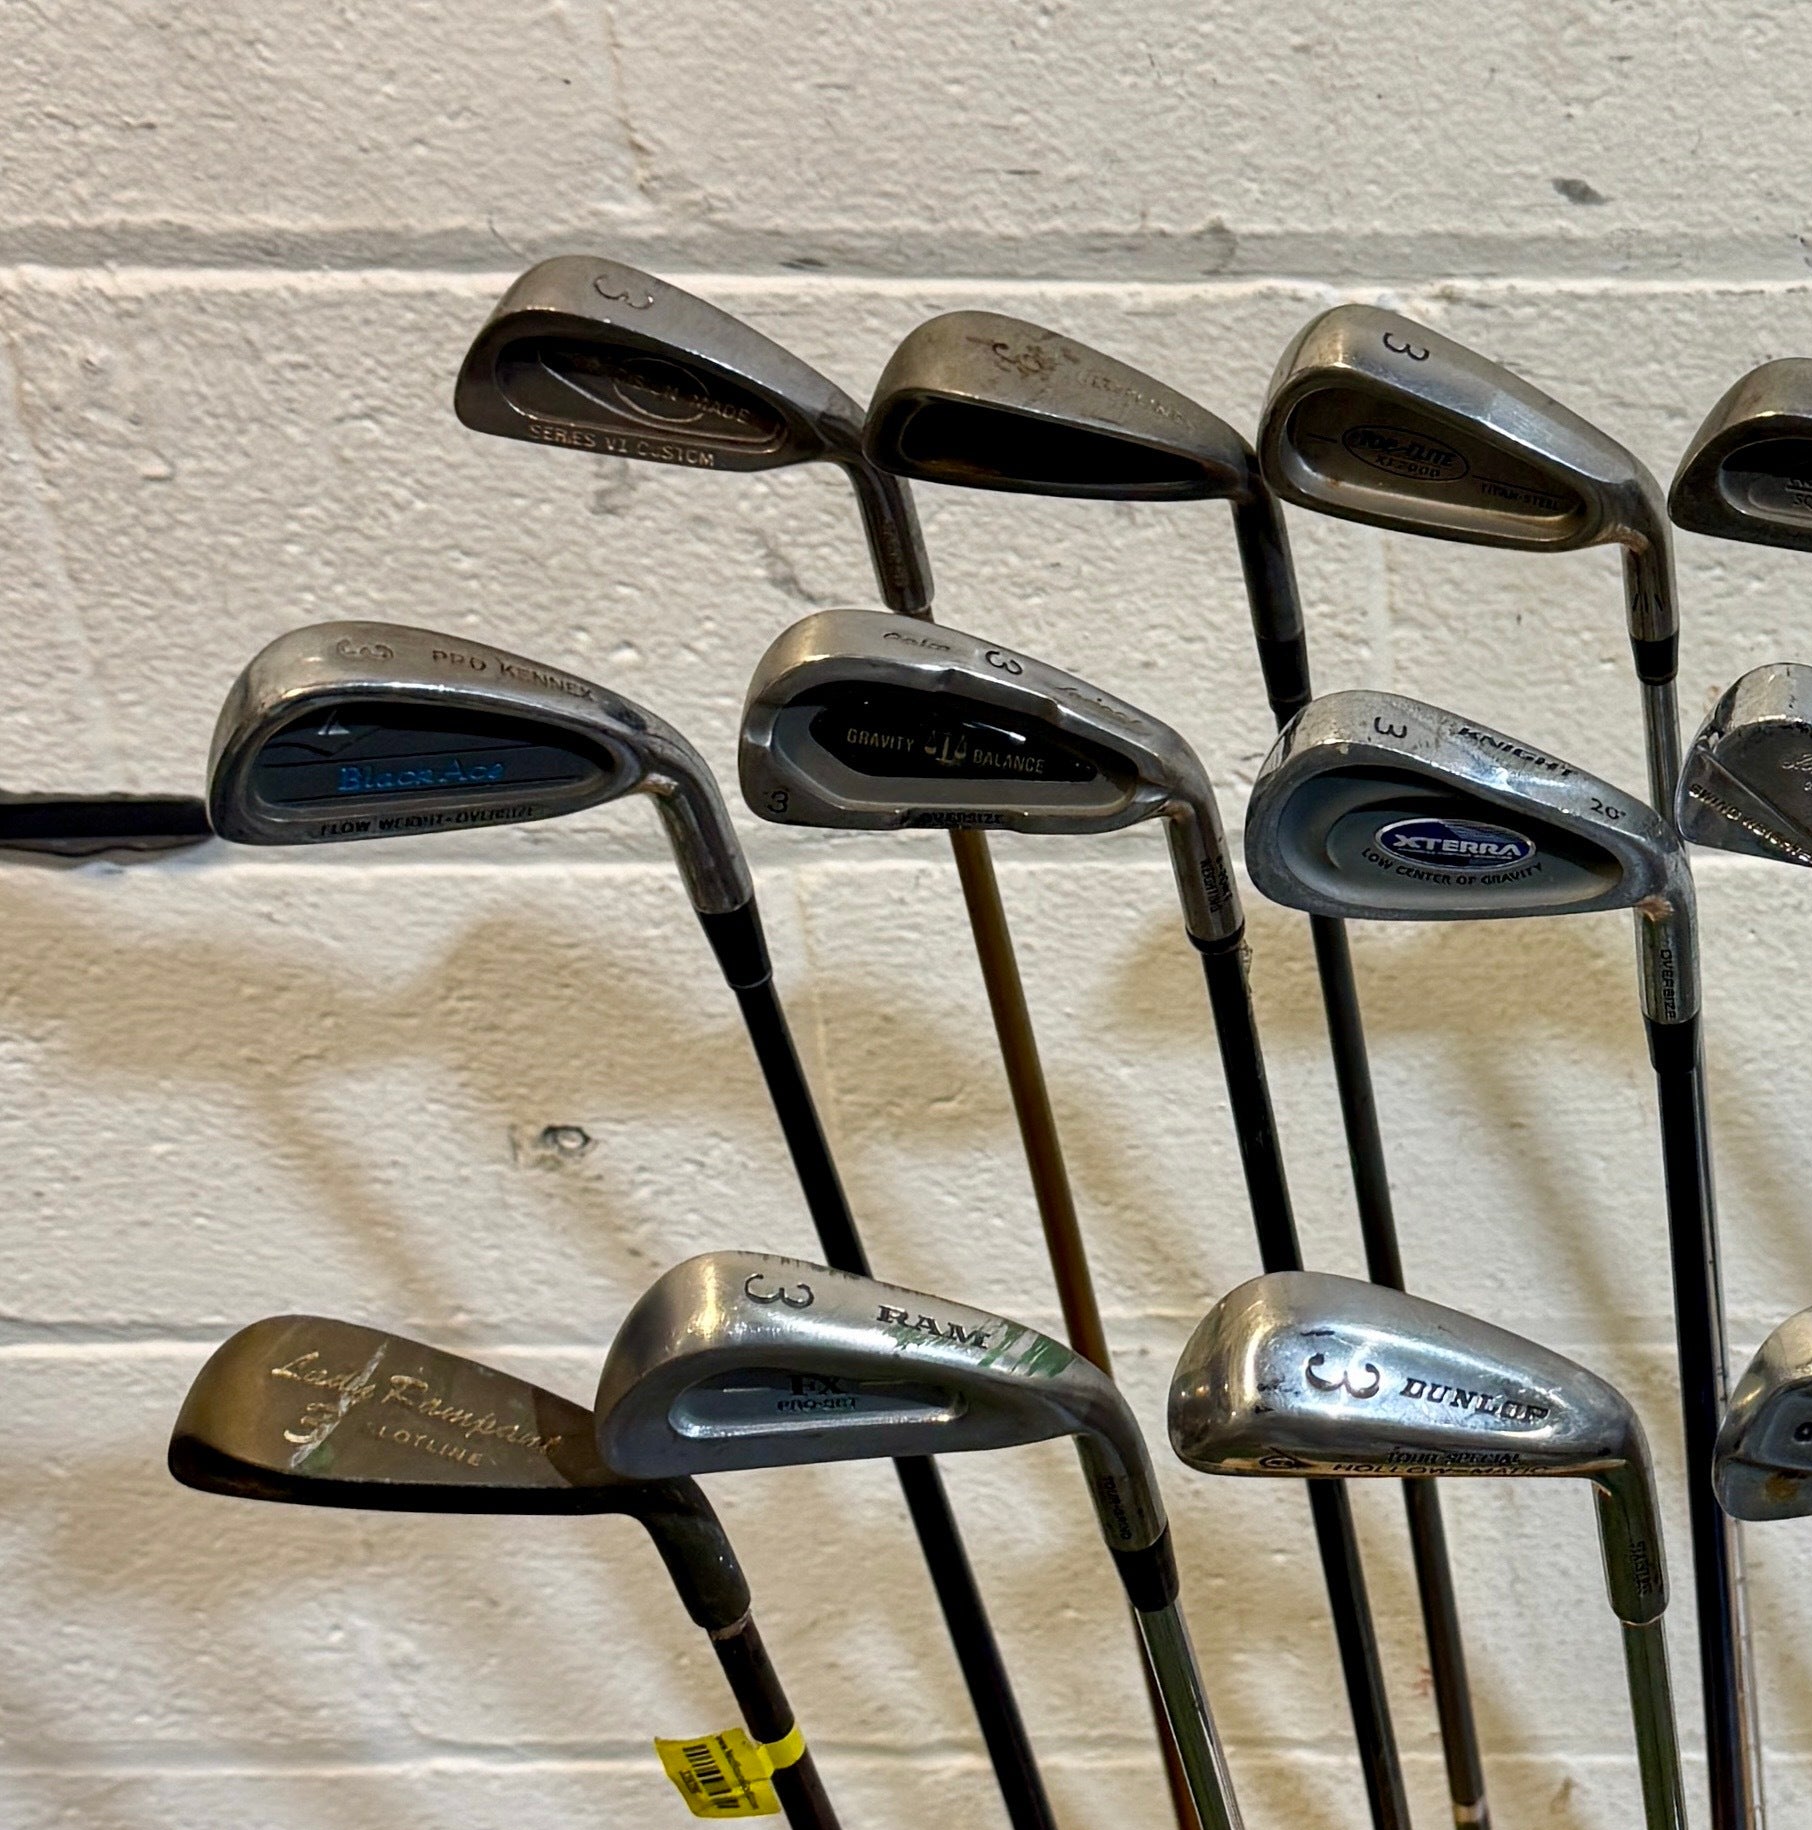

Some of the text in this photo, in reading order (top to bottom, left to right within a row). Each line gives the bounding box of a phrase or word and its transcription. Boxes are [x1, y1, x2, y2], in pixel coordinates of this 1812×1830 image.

[593, 275, 653, 309] 3
[1382, 332, 1430, 361] 3
[529, 424, 597, 450] SERIES
[432, 649, 595, 701] PRO KENNEX
[985, 649, 1024, 676] 3
[846, 727, 915, 754] GRAVITY
[1374, 716, 1407, 739] 3
[972, 748, 1045, 775] BALANCE
[1457, 725, 1578, 776] KNIGHT
[767, 790, 790, 814] 3
[1393, 833, 1522, 858] XTERRA
[1361, 847, 1392, 869] LOW
[1396, 864, 1451, 886] CENTER
[1456, 873, 1475, 885] OF
[1481, 862, 1543, 885] GRAVITY
[744, 1273, 814, 1309] 3
[877, 1304, 990, 1350] RAM
[271, 1350, 375, 1405] Lady
[788, 1375, 847, 1397] FX
[1304, 1352, 1380, 1399] 3
[1400, 1376, 1550, 1423] DUNLOP
